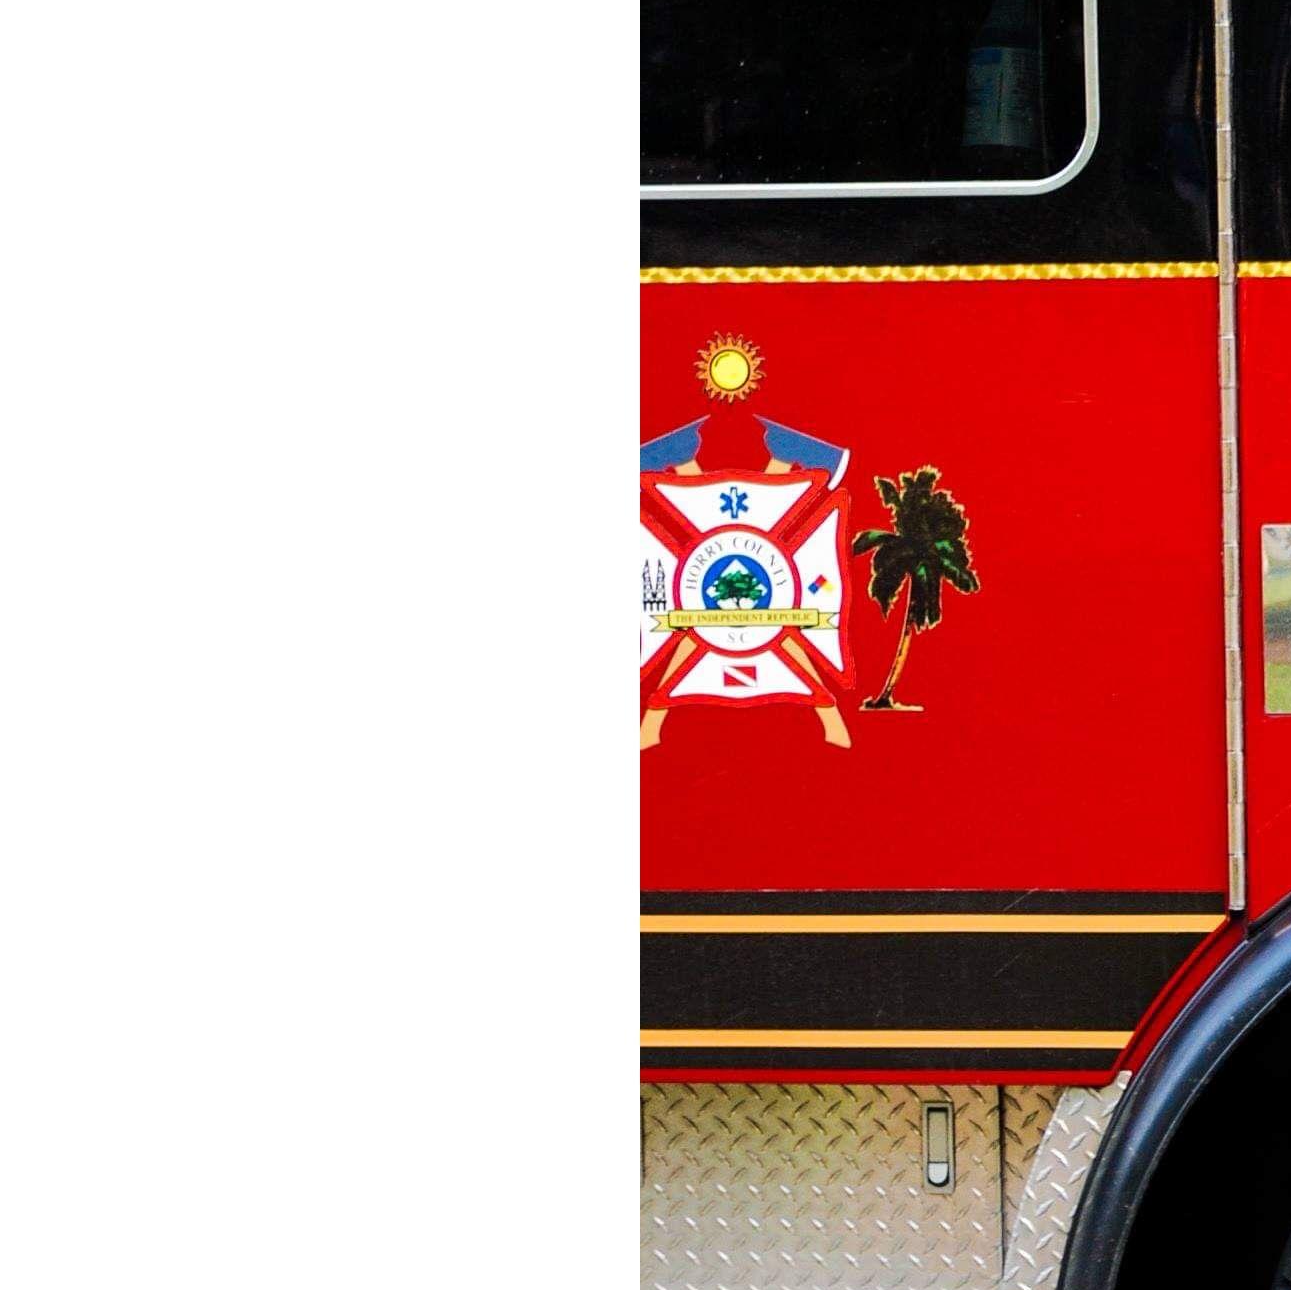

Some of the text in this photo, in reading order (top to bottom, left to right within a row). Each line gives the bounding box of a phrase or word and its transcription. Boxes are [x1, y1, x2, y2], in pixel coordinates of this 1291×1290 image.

[685, 537, 788, 590] HORRY COUNTY
[675, 612, 811, 623] THE INDEPENDENT REPUBLIC
